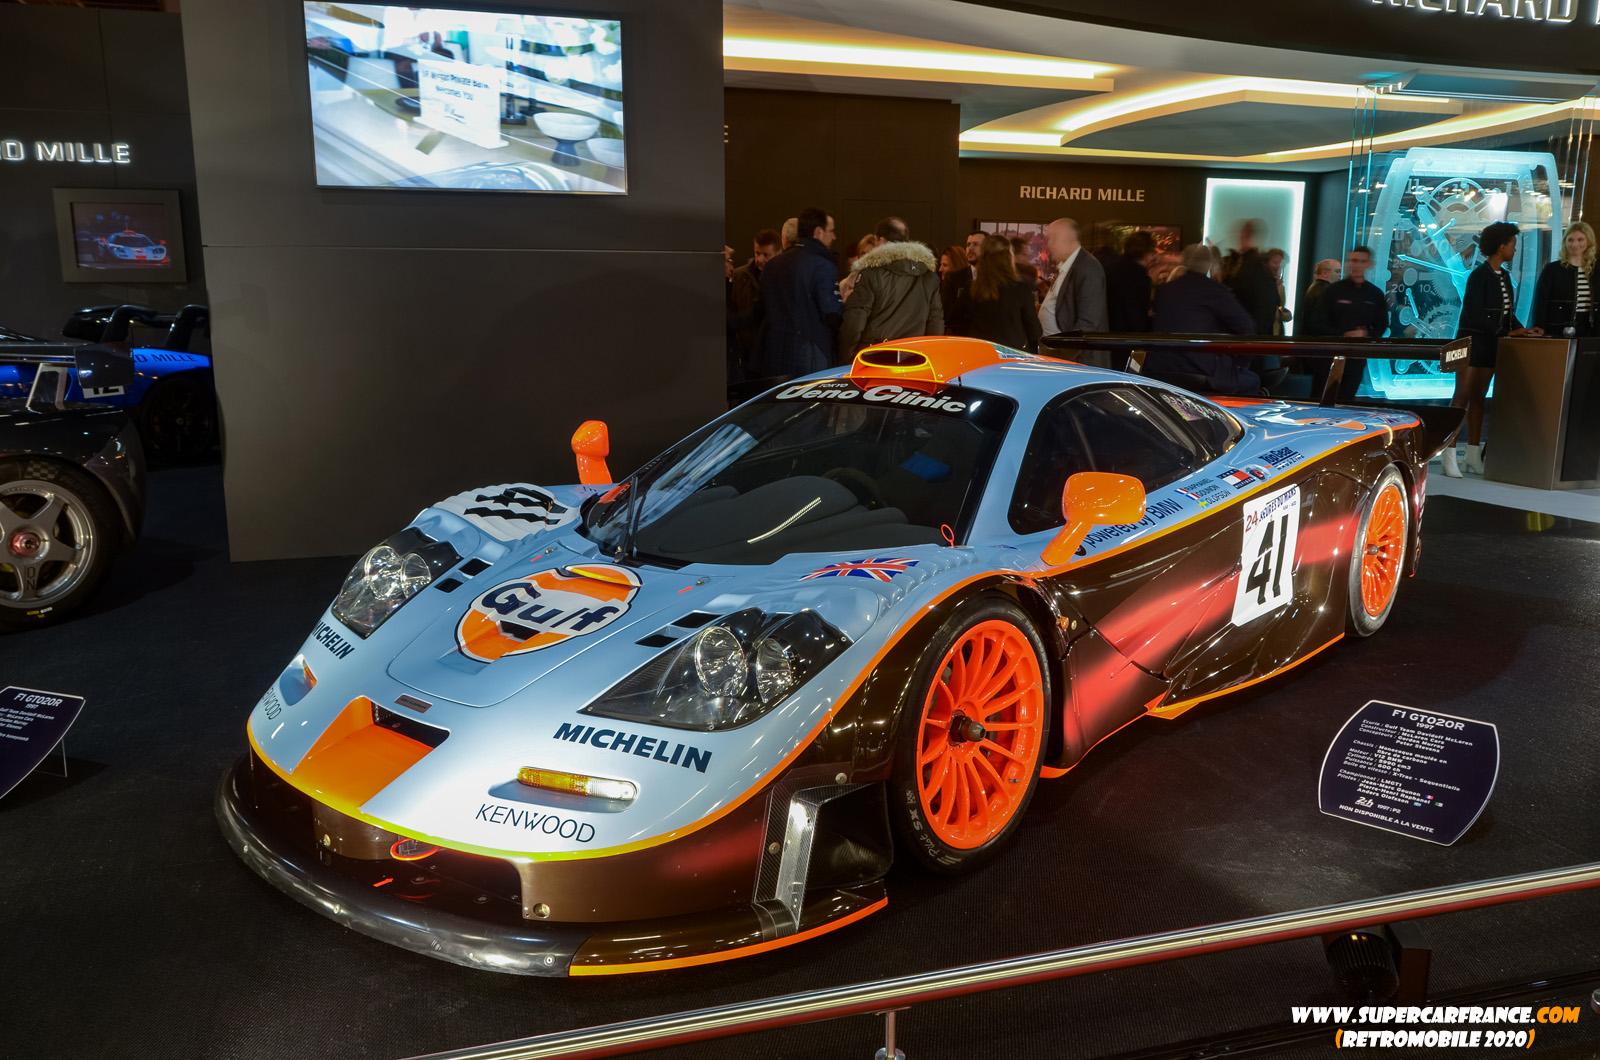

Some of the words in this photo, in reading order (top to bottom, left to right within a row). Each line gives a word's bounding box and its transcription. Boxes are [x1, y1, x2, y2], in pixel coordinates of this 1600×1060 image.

[35, 140, 131, 164] MILLE
[1020, 185, 1092, 201] RICHARD
[1097, 188, 1145, 202] MILLE
[150, 353, 198, 363] MILLE
[1445, 346, 1468, 363] MICHELIN
[775, 385, 860, 400] Ueno
[863, 385, 967, 413] Clinic
[1083, 525, 1139, 548] powered
[1146, 497, 1184, 520] BMW
[1245, 510, 1259, 532] 24
[1245, 514, 1289, 605] 41
[481, 582, 620, 632] Gulf
[14, 692, 27, 701] F1
[1392, 709, 1407, 718] F1
[1417, 722, 1435, 730] 1997
[1400, 726, 1416, 734] Team
[1417, 730, 1444, 740] Davidoff
[1445, 736, 1473, 746] McLaren
[1401, 731, 1428, 741] McLaren
[1430, 737, 1445, 745] Cars
[1420, 740, 1444, 750] Murray
[553, 722, 713, 774] MICHELIN
[1396, 739, 1413, 747] Peter
[1415, 743, 1440, 753] Stevens
[1357, 787, 1379, 797] Anders
[475, 803, 596, 843] KENWOOD
[1339, 804, 1354, 812] NON
[1354, 808, 1393, 822] DISPONIBLE
[1412, 822, 1434, 833] VENTE
